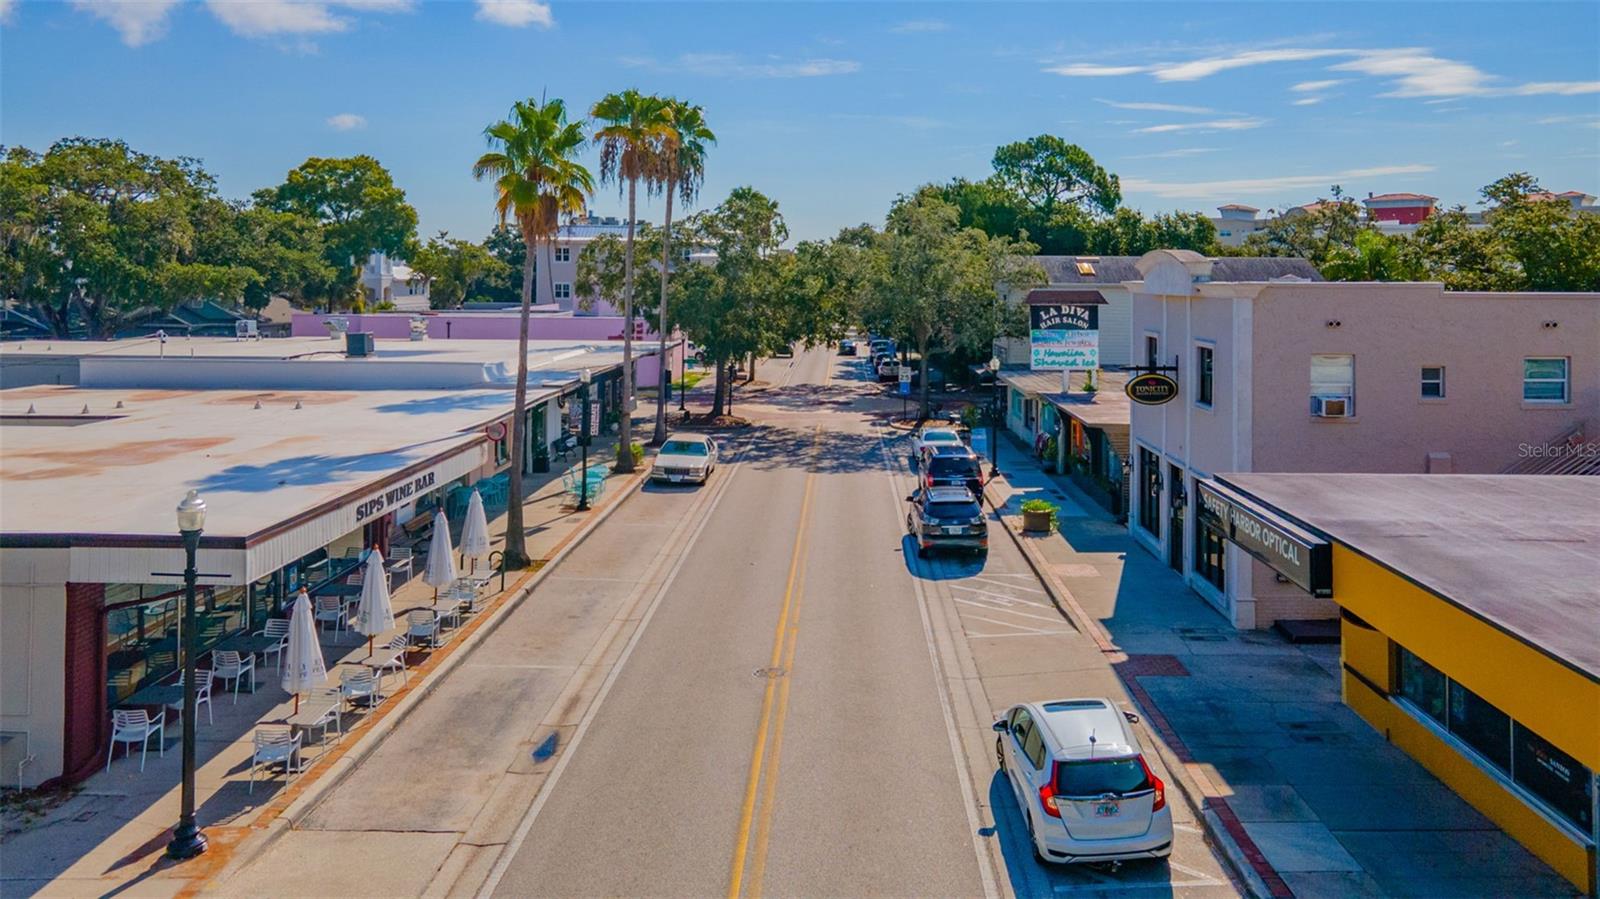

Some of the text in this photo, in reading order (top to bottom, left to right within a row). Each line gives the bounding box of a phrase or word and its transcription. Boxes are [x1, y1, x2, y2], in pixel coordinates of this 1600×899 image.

[1040, 305, 1089, 320] LA DIVA
[1040, 316, 1089, 329] HAIR SALON
[1044, 349, 1085, 357] Hawaiian
[356, 471, 435, 522] SIPS WINE BAR
[1203, 494, 1300, 566] SAFETY HARBOR OPTICAL
